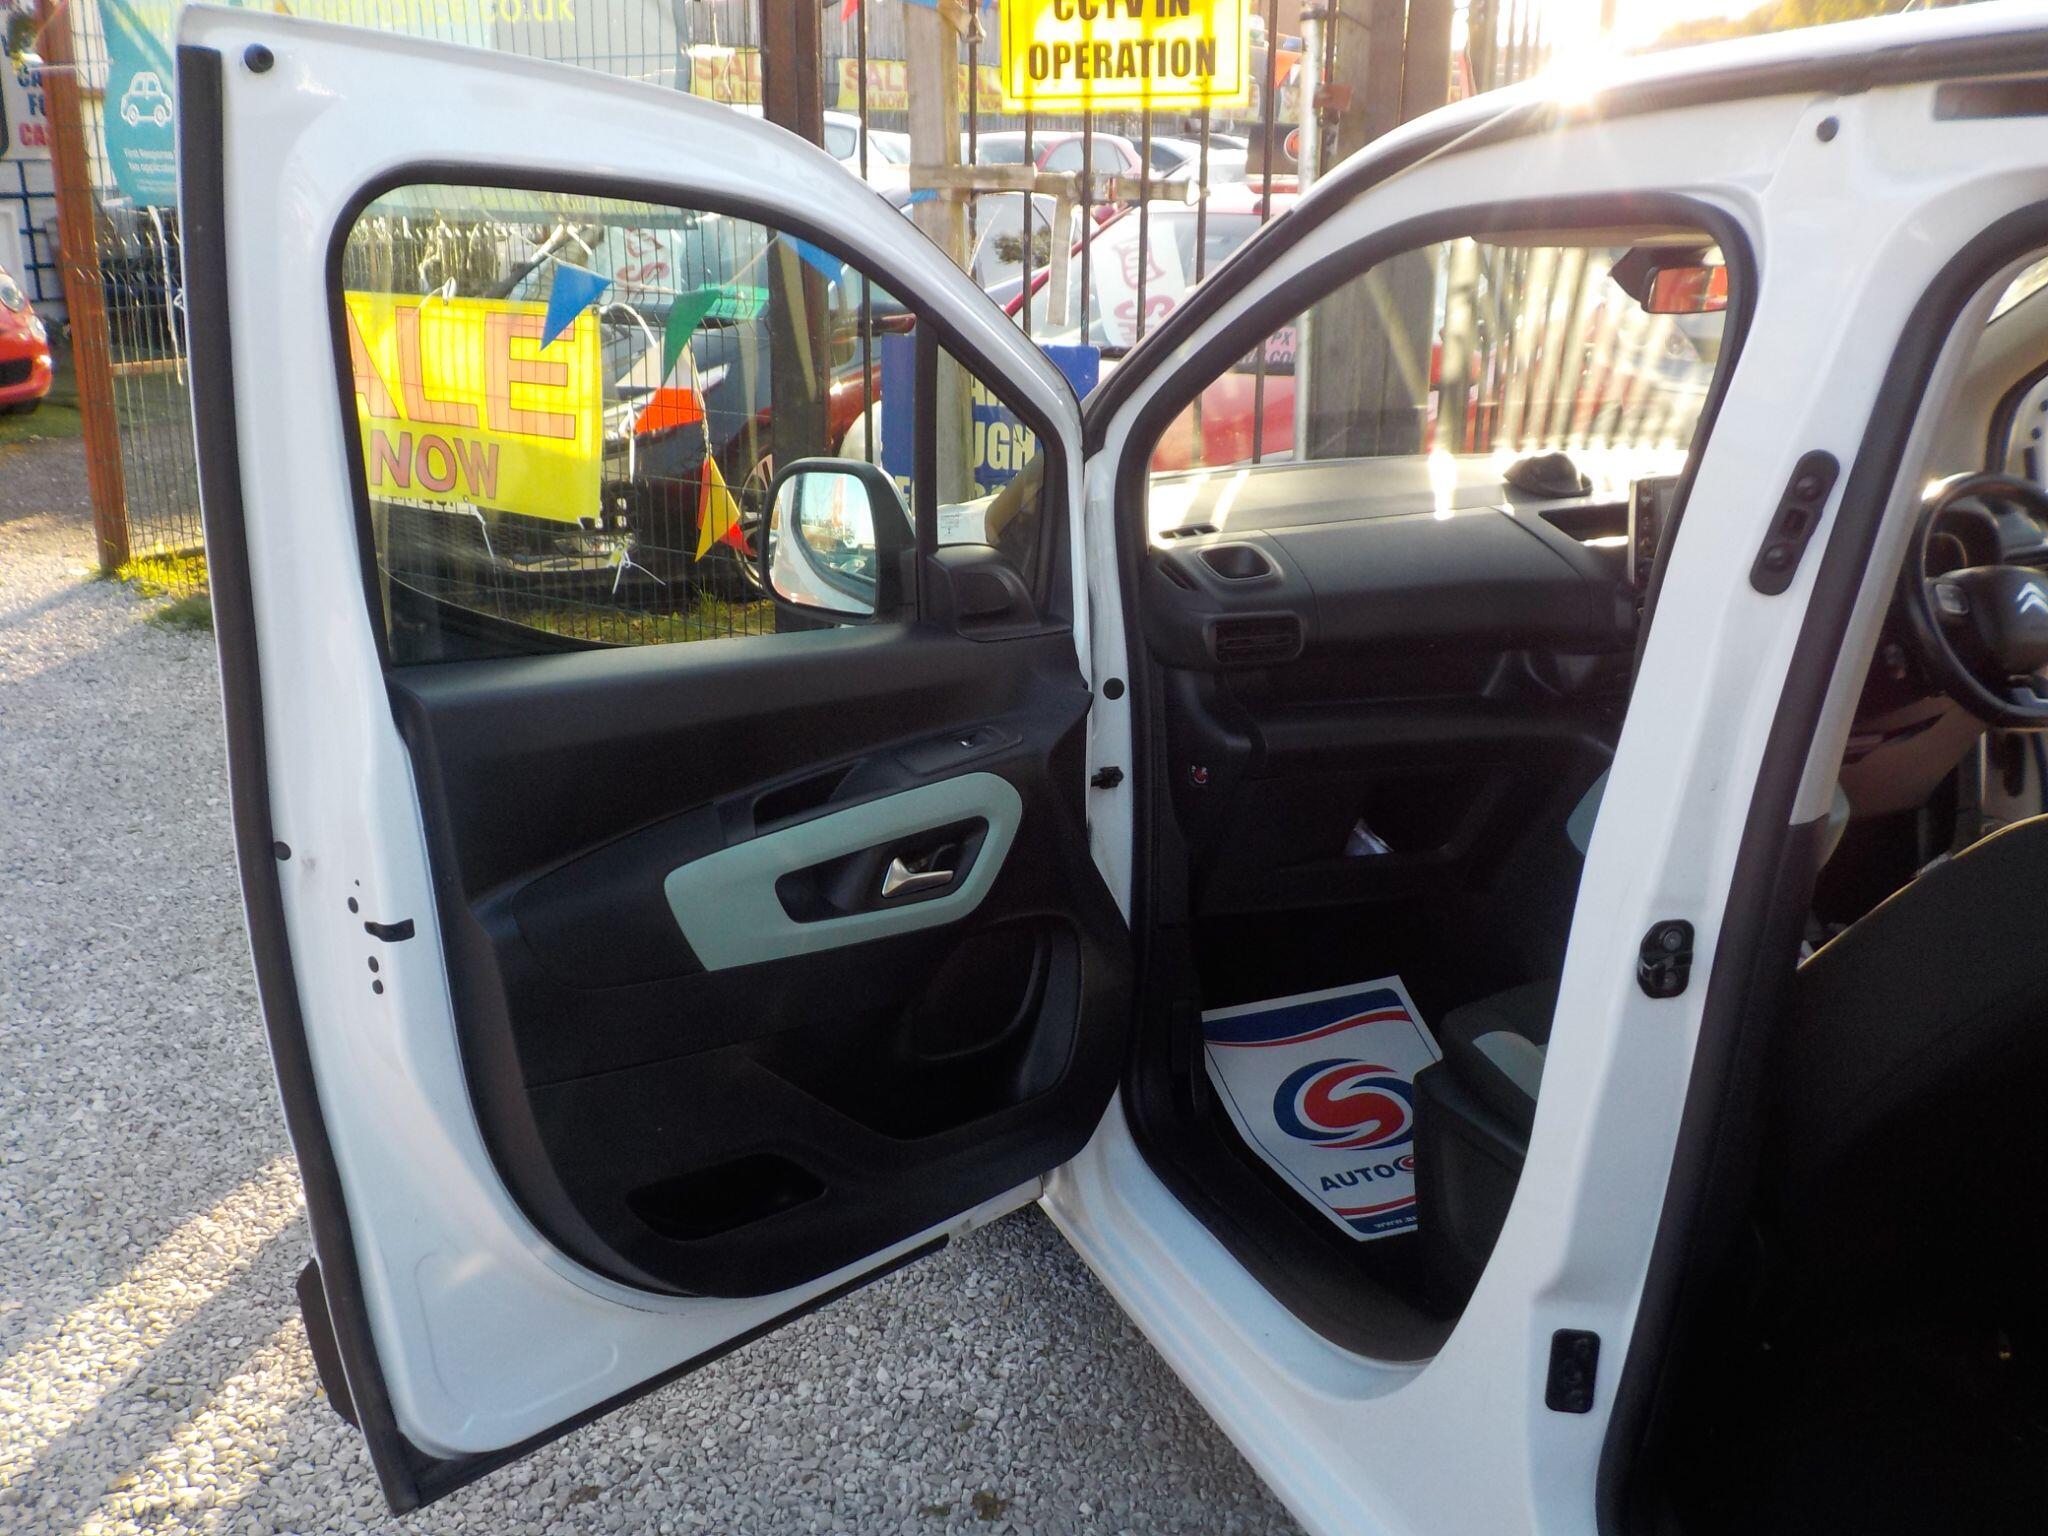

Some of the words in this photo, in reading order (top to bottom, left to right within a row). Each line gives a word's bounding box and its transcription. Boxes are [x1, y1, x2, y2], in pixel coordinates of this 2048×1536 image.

[694, 53, 761, 81] SAL
[1028, 38, 1217, 80] OPERATION
[370, 429, 499, 500] NOW
